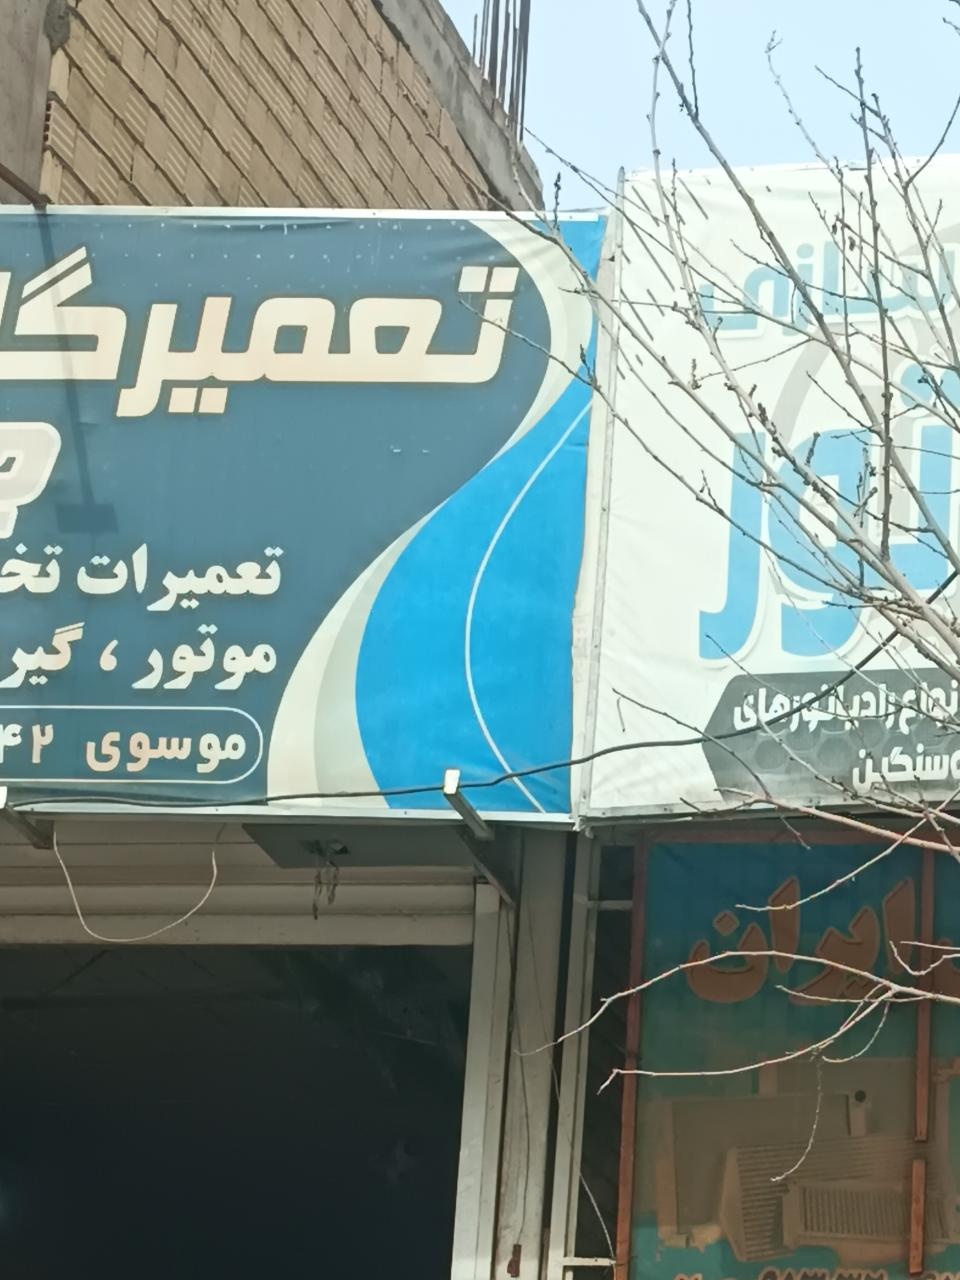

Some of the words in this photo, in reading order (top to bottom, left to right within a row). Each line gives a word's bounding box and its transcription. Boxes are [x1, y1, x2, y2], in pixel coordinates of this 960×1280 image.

[0, 245, 520, 418] تعمیرگ
[77, 543, 285, 612] تعمیرات
[131, 624, 277, 690] موتور
[86, 731, 247, 773] موسوی
[686, 876, 914, 1006] ایران
